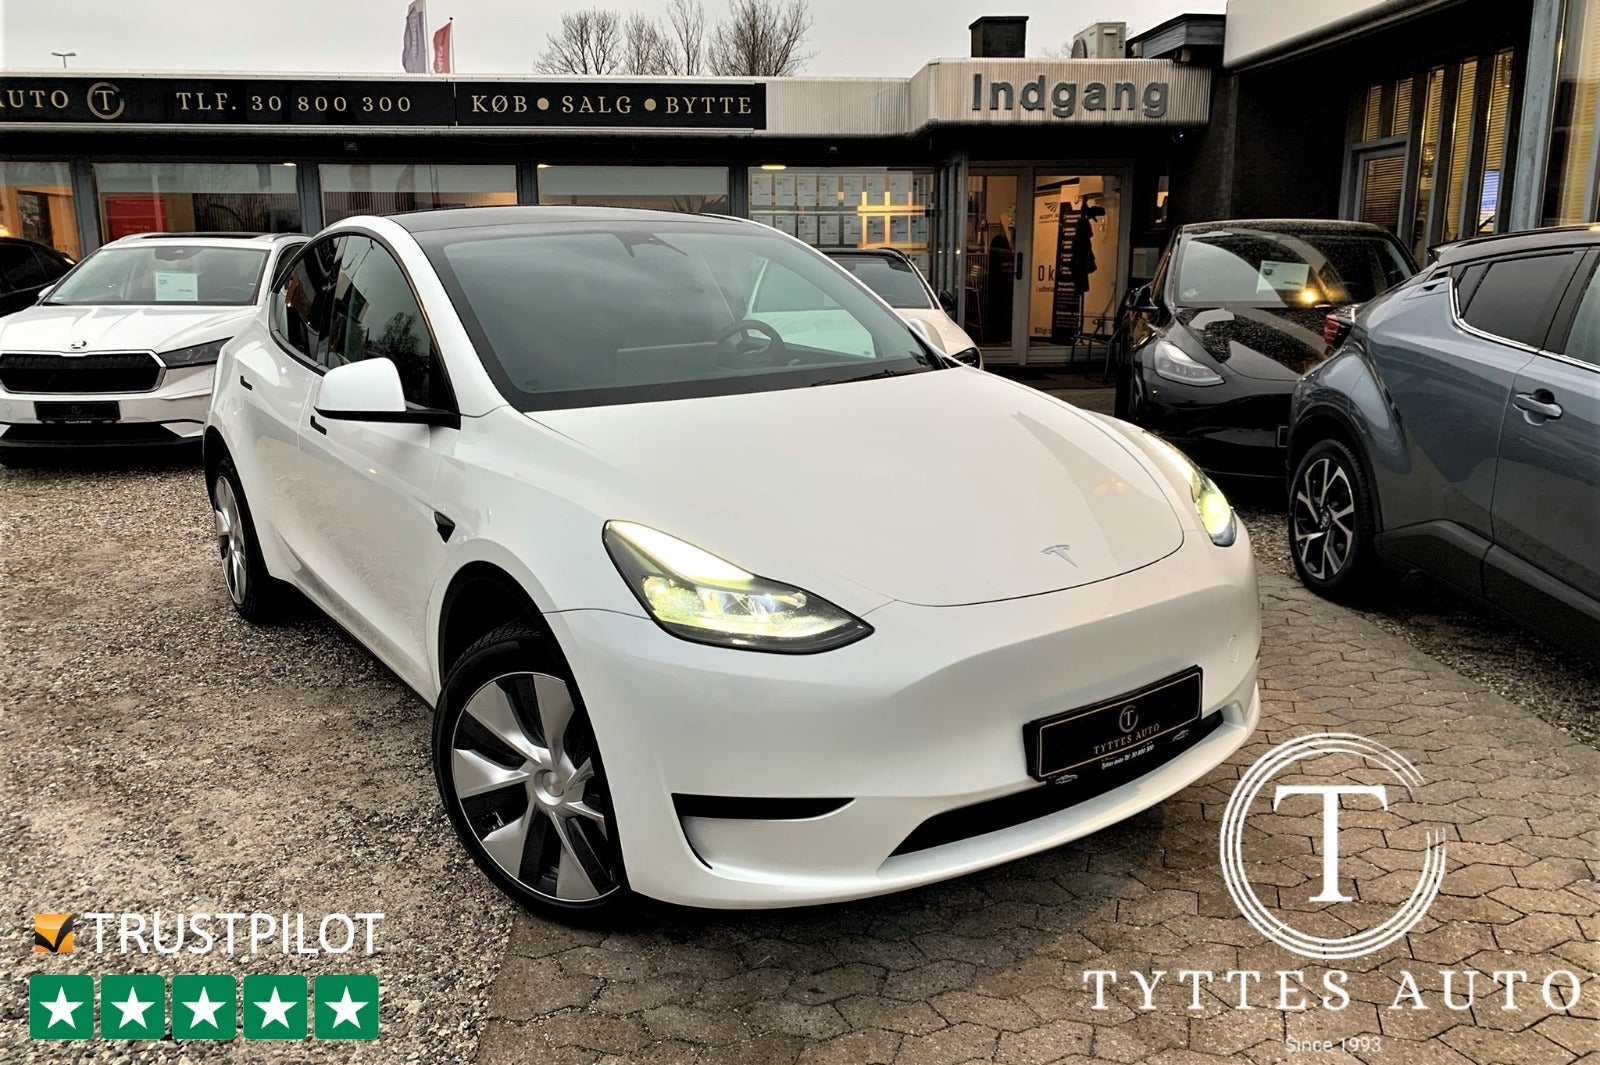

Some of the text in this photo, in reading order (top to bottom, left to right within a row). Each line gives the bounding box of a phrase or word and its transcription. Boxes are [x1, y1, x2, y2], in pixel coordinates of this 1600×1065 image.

[176, 92, 411, 113] TLF. 30 800 300
[471, 94, 752, 115] KØB SALG BYTTE
[972, 73, 1168, 118] Indgang
[1093, 723, 1159, 755] TYTTES AUTO
